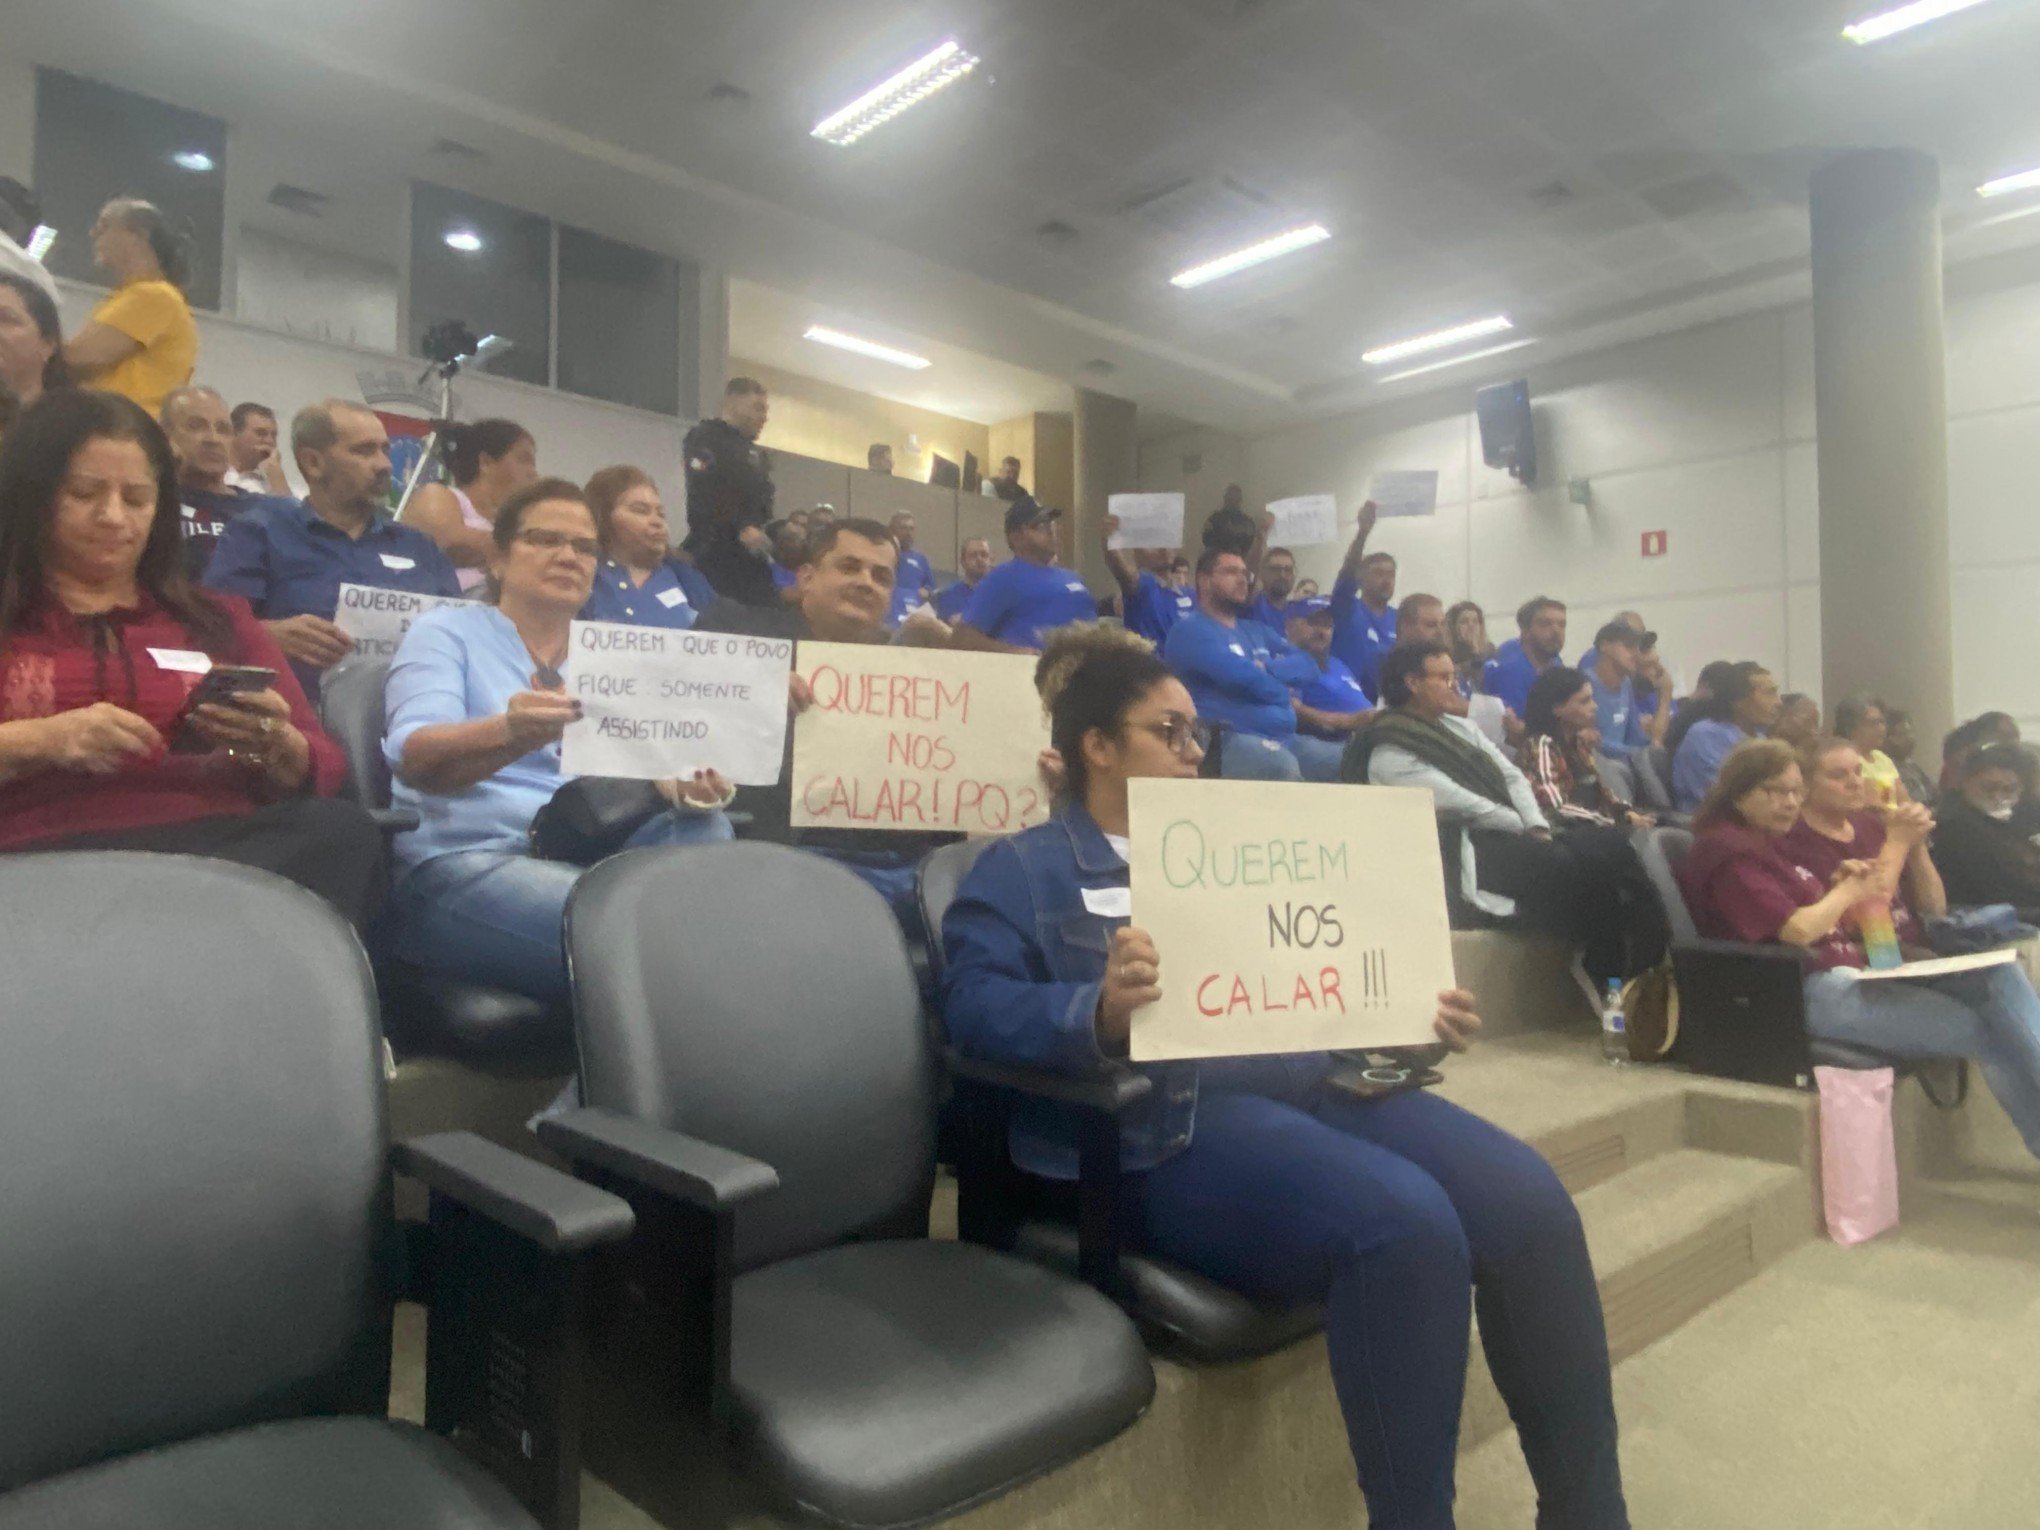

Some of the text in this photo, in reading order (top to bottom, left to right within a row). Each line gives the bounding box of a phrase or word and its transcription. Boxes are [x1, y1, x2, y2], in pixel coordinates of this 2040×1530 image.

[344, 588, 422, 614] QUEREM
[581, 627, 789, 660] QUEREM QUE O POVO
[577, 674, 751, 700] FIQUE SOMENTE
[809, 665, 970, 724] QUEREM
[597, 716, 709, 740] ASSISTINDO
[888, 731, 956, 771] NOS
[1161, 819, 1349, 890] QUEREM
[1267, 901, 1345, 949] NOS
